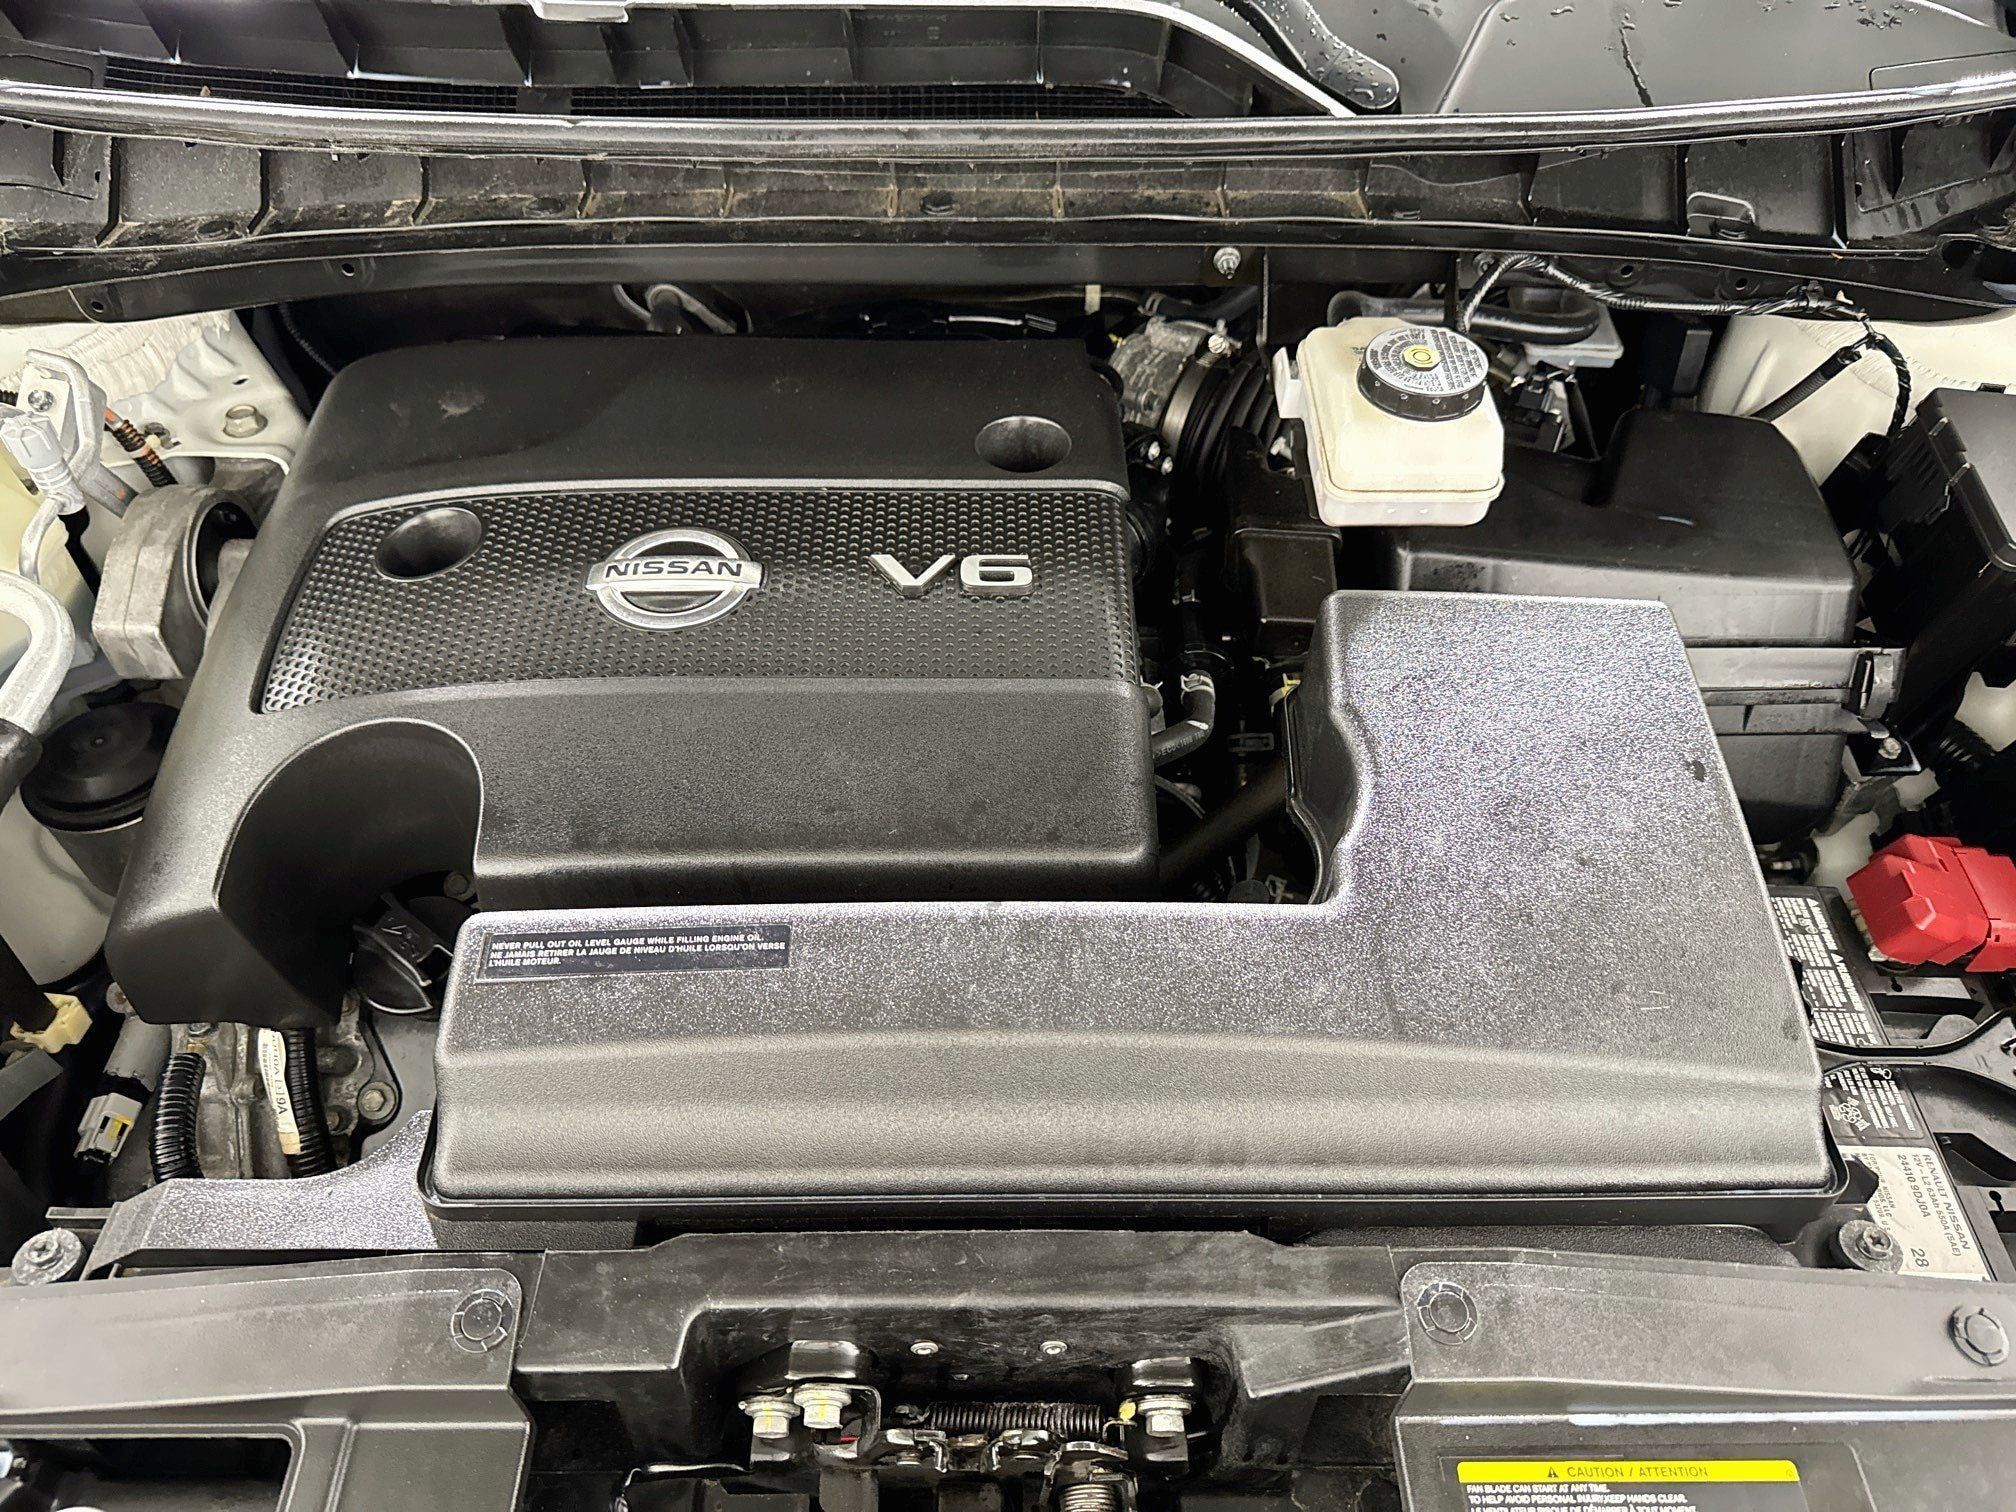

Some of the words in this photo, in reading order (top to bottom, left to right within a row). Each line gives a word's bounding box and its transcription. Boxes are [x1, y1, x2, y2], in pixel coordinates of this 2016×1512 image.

[604, 559, 743, 579] NISSAN
[868, 553, 1035, 598] V6
[490, 951, 503, 959] NE
[503, 950, 536, 958] JAMAIS
[538, 948, 574, 958] RETIRER
[576, 948, 587, 956] LA
[588, 947, 618, 956] JAUGE
[619, 946, 632, 954] DE
[634, 946, 666, 954] NIVEAU
[668, 944, 703, 952] D'HUILE
[704, 943, 756, 952] LORSQU'ON
[757, 942, 786, 950] VERSE
[492, 942, 522, 950] NEVER
[523, 941, 545, 950] PULL
[547, 940, 566, 948] OUT
[568, 939, 582, 948] OIL
[584, 938, 612, 947] LEVEL
[614, 938, 645, 946] GAUGE
[647, 936, 675, 945] WHILE
[676, 935, 710, 944] FILLING
[712, 934, 746, 943] ENGINE
[747, 934, 764, 942] OIL.
[488, 959, 522, 967] L'HUILE
[522, 958, 562, 966] MOTEUR.
[1897, 1154, 1916, 1182] 24410
[1883, 1186, 1896, 1209] NISSAN
[1911, 1154, 1922, 1171] 12V
[1936, 1210, 1950, 1231] 550A
[1945, 1232, 1962, 1256] (SAE)
[1922, 1154, 1948, 1200] RENAULT
[1944, 1202, 1970, 1250] NISSAN
[1910, 1248, 1930, 1268] 28
[1567, 1466, 1624, 1478] CAUTION
[1640, 1466, 1708, 1478] ATTENTION
[1466, 1484, 1484, 1493] FAN
[1484, 1484, 1512, 1493] BLADE
[1513, 1484, 1531, 1493] CAN
[1532, 1484, 1557, 1493] START
[1559, 1484, 1568, 1492] AT
[1571, 1484, 1587, 1492] ANY
[1588, 1484, 1610, 1492] TIME.
[1468, 1495, 1481, 1504] TO
[1482, 1495, 1504, 1504] HELP
[1505, 1494, 1530, 1504] AVOID
[1531, 1494, 1576, 1504] PERSONAL
[1627, 1494, 1657, 1503] HANDS
[1658, 1494, 1688, 1503] CLEAR.
